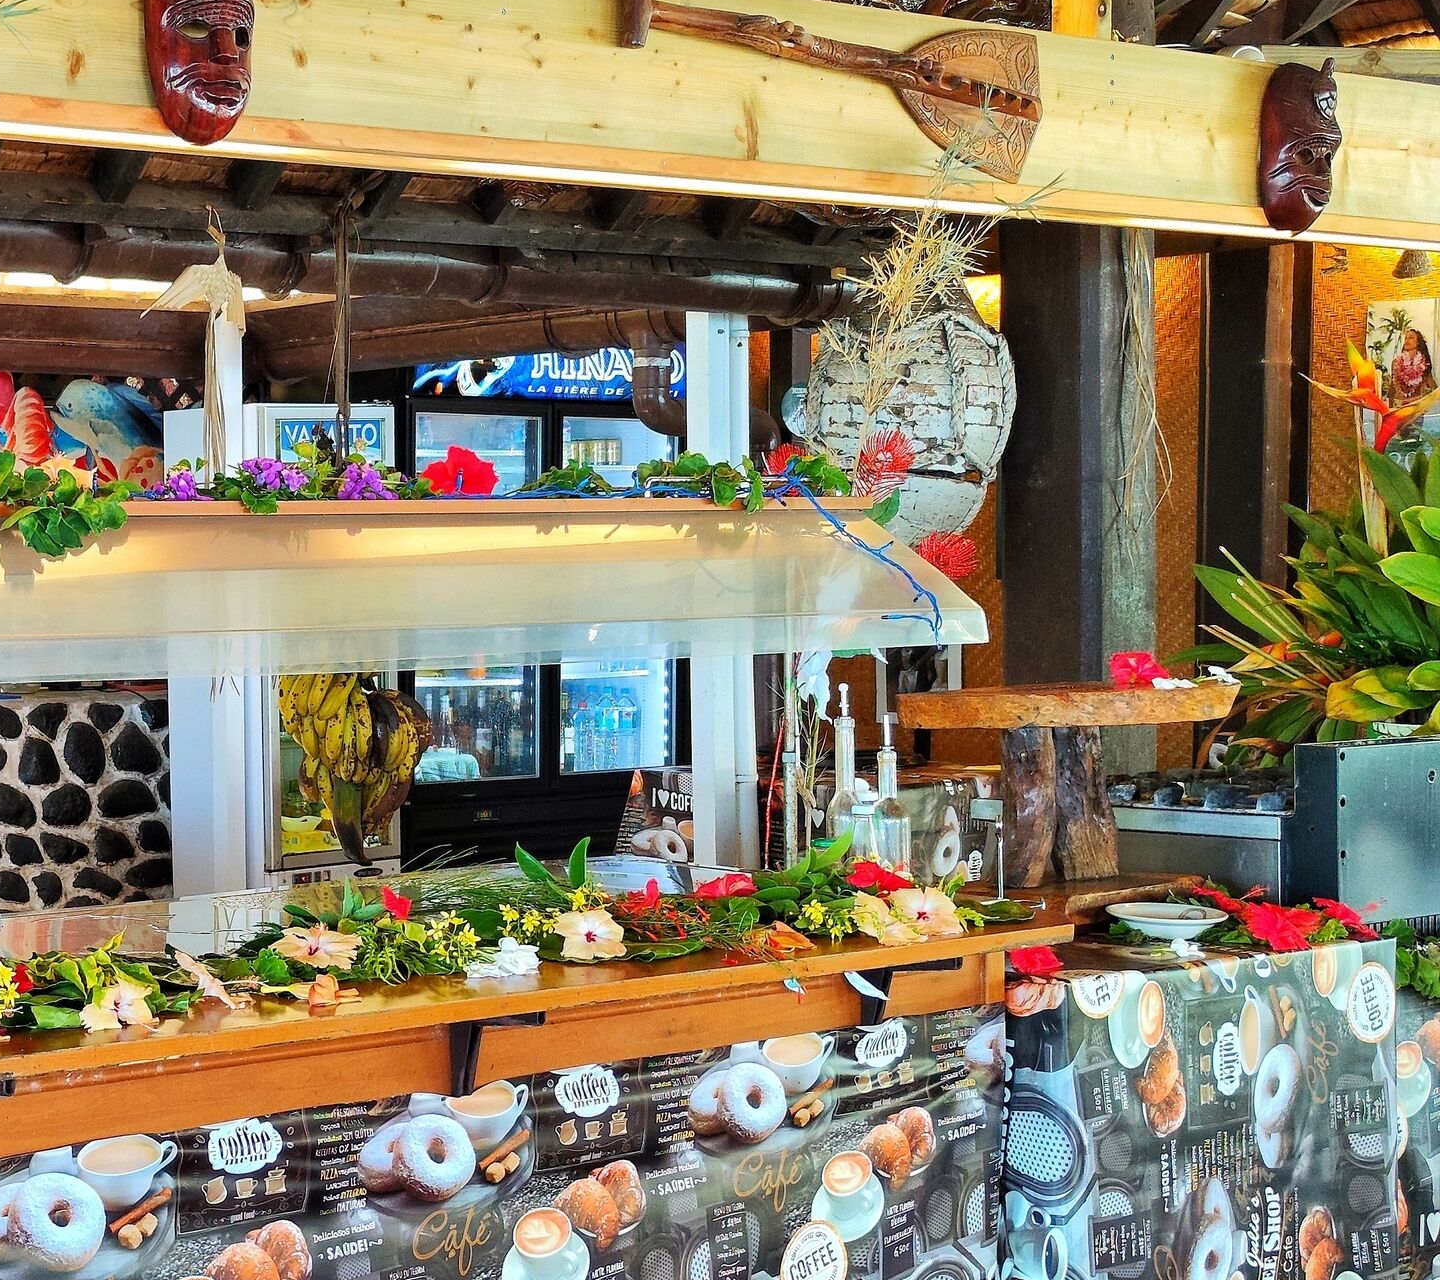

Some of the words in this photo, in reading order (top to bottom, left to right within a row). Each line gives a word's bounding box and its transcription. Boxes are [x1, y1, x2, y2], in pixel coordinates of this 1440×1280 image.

[527, 385, 540, 393] LA
[560, 385, 597, 396] BIÈRE
[604, 388, 624, 396] DE
[652, 787, 656, 808] I
[1361, 973, 1383, 1032] COFFEE
[564, 1072, 610, 1103] coffee
[218, 1125, 272, 1161] coffee
[225, 1153, 268, 1166] menu
[1263, 1186, 1282, 1253] SHOP
[327, 1238, 368, 1261] SAÚDE!
